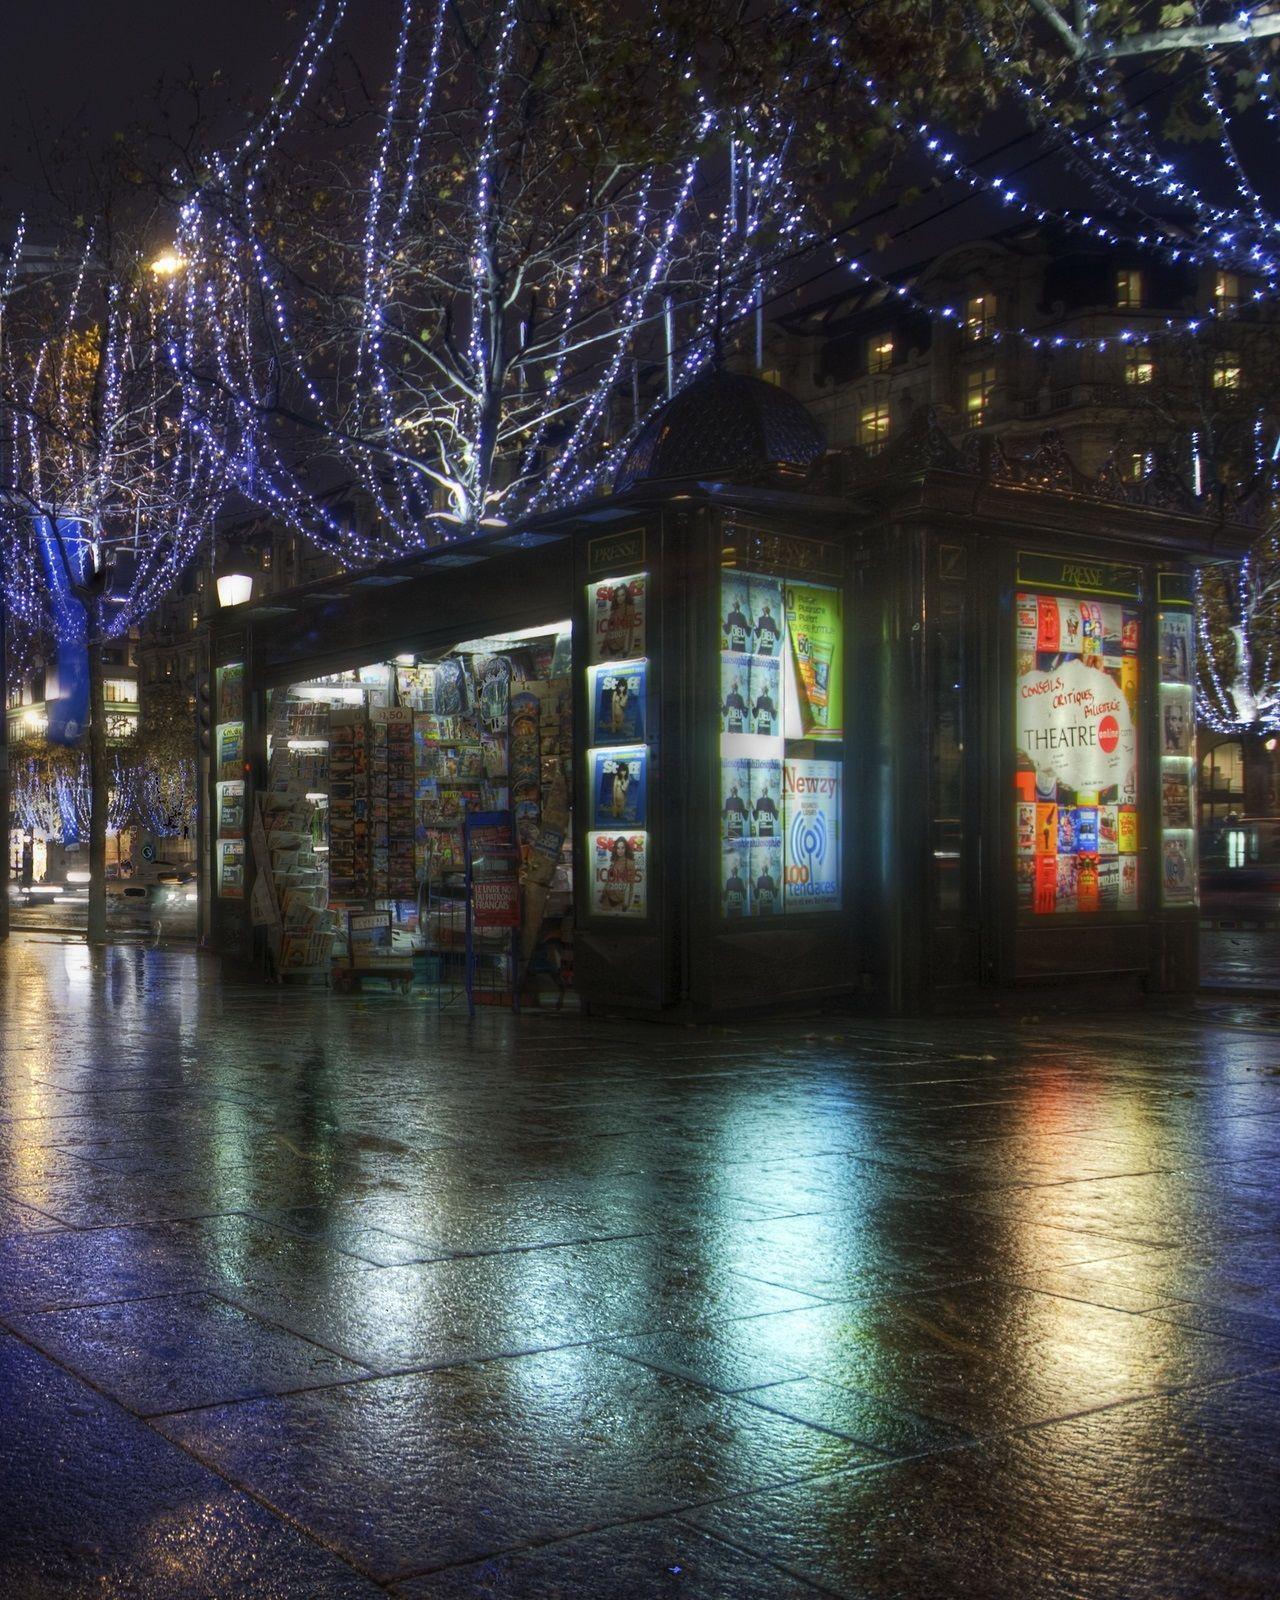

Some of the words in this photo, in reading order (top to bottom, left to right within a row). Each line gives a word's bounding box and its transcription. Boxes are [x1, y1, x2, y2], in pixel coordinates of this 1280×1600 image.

[1062, 564, 1104, 588] PRESSE
[1023, 725, 1097, 751] THEATRE
[784, 766, 837, 800] Newzy
